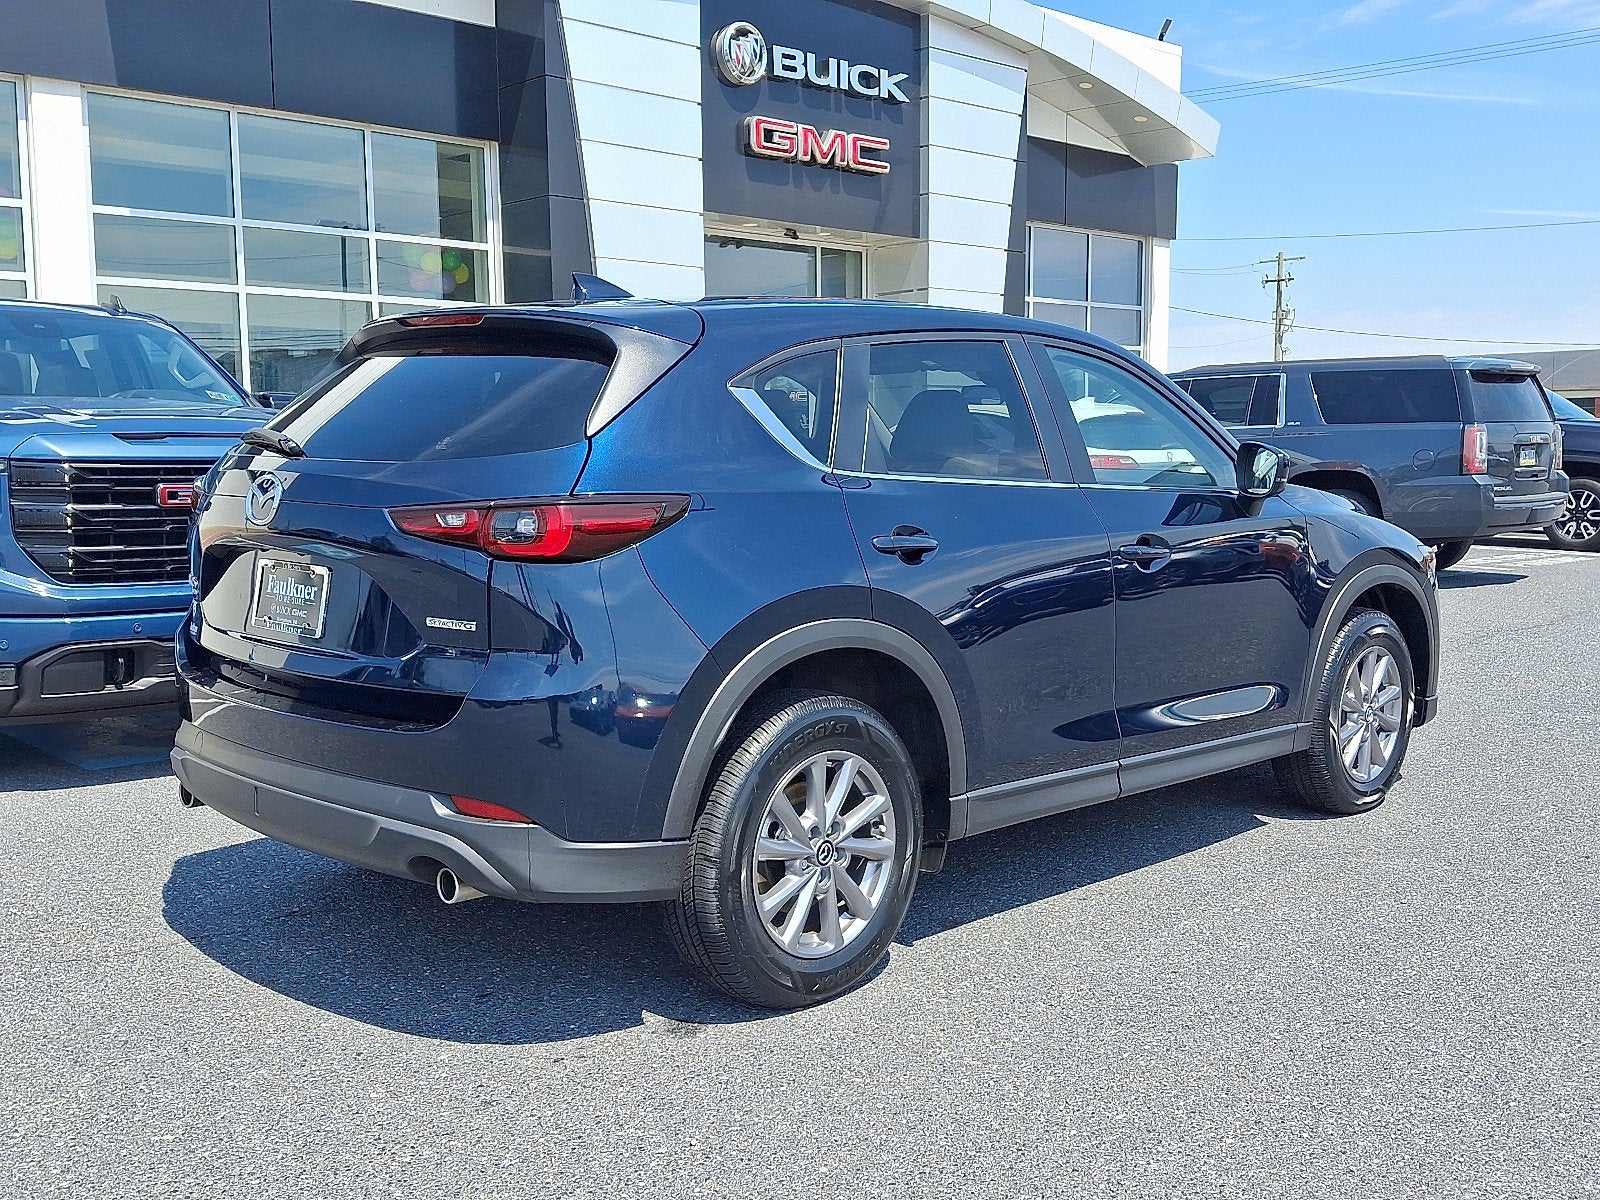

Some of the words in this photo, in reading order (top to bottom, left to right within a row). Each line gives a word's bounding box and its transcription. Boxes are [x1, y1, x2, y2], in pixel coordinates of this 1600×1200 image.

[772, 44, 911, 103] BUICK
[747, 116, 890, 175] GMC
[266, 574, 318, 600] Faulkner
[266, 621, 303, 635] Faulkner
